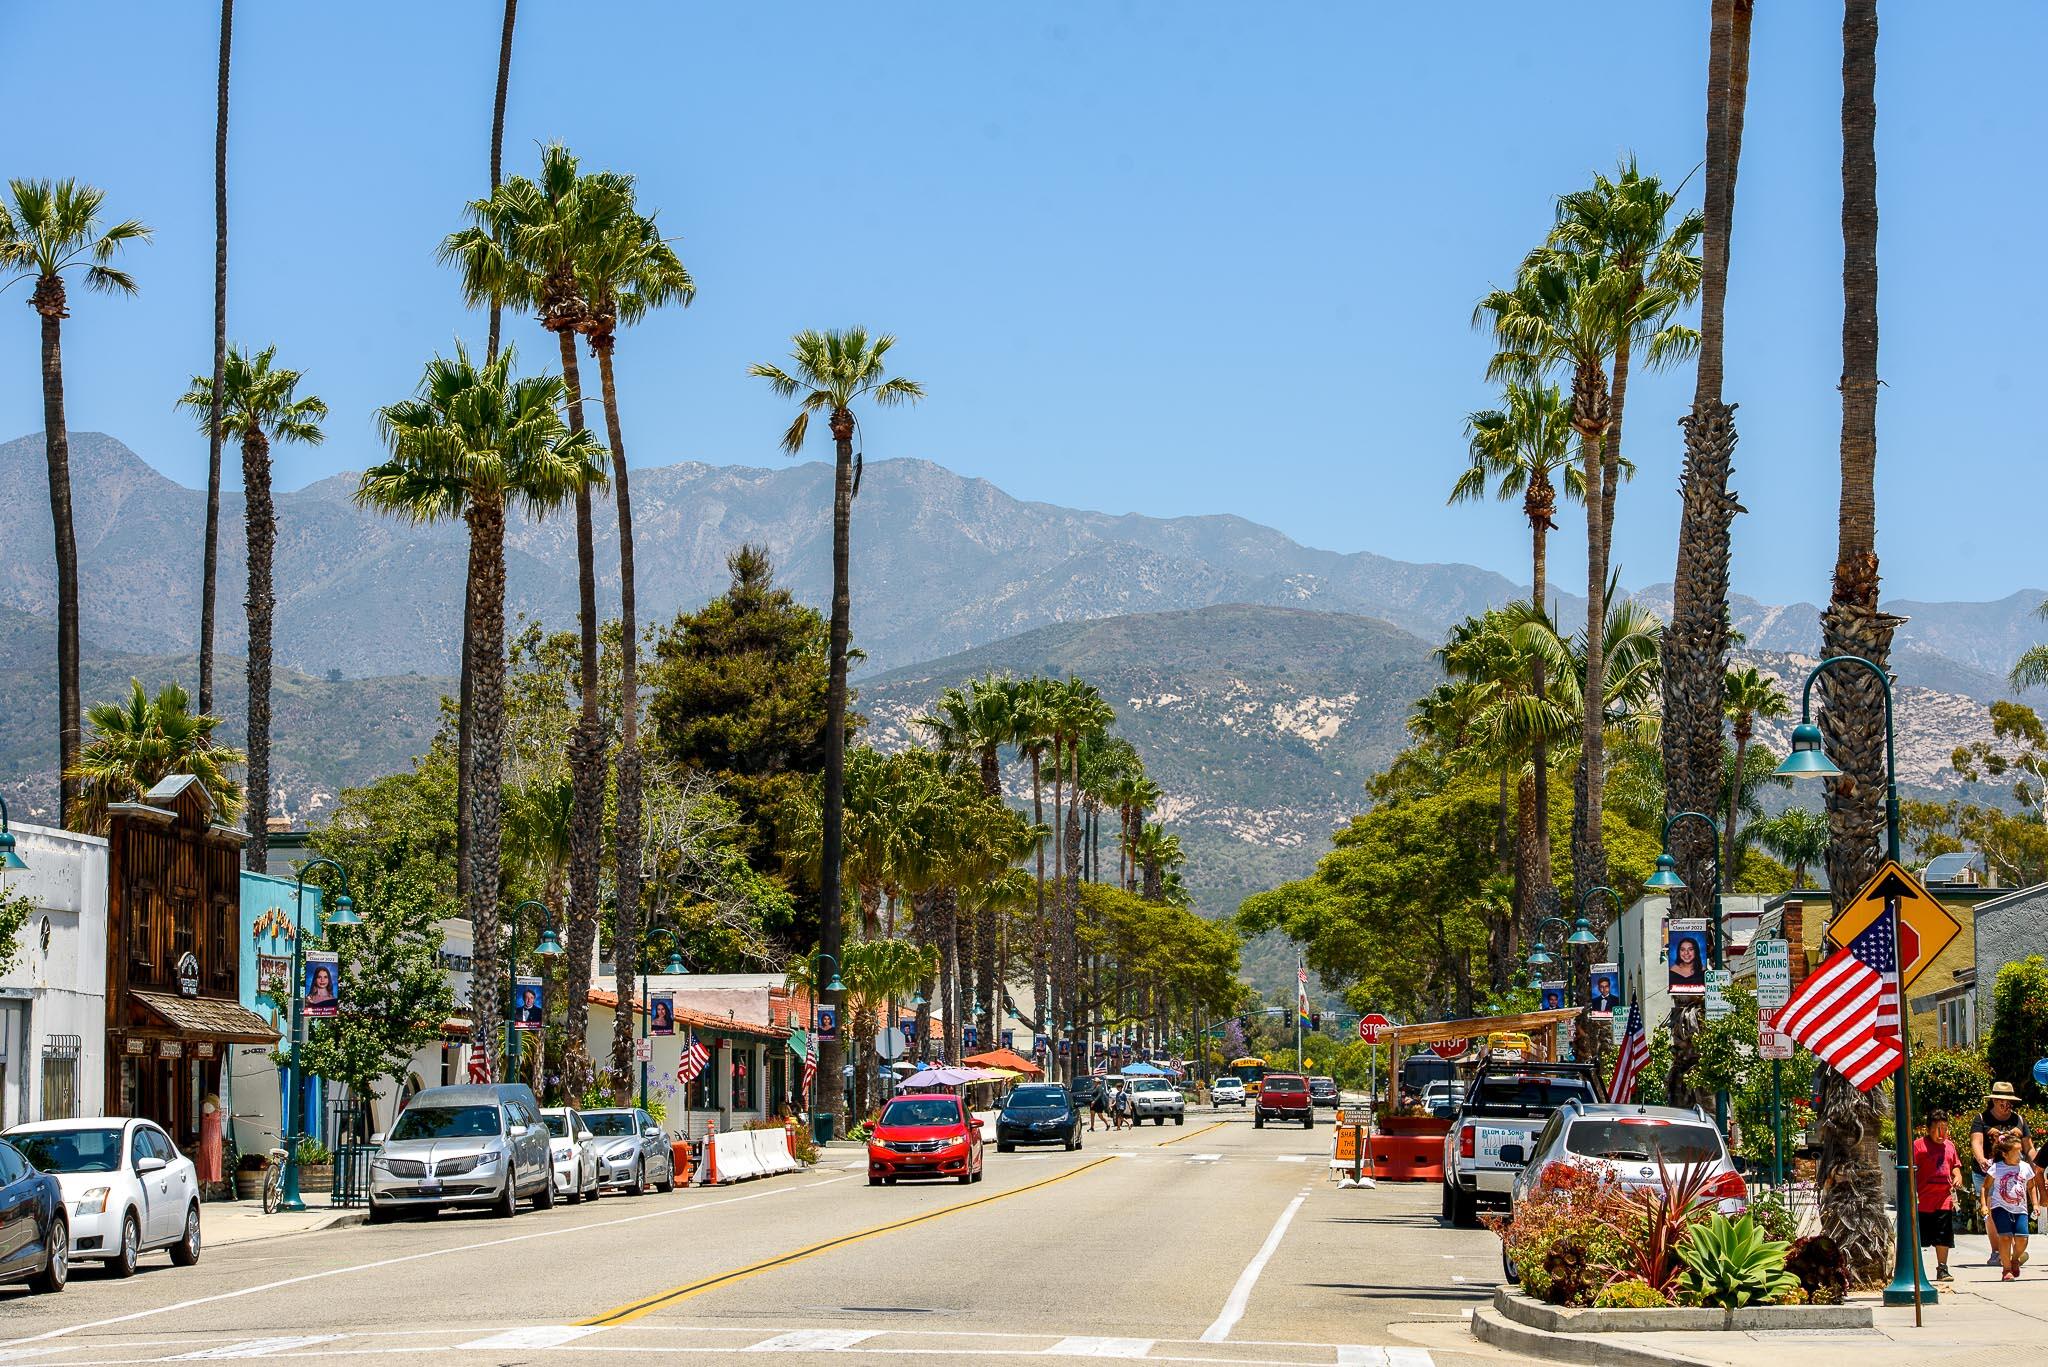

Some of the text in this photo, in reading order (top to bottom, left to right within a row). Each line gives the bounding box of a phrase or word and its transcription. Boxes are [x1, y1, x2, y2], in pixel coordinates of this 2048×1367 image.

[1756, 943, 1786, 955] 90 MINUTE
[1758, 958, 1786, 968] PARKING
[1760, 1009, 1772, 1020] NO
[1762, 1034, 1773, 1045] NO
